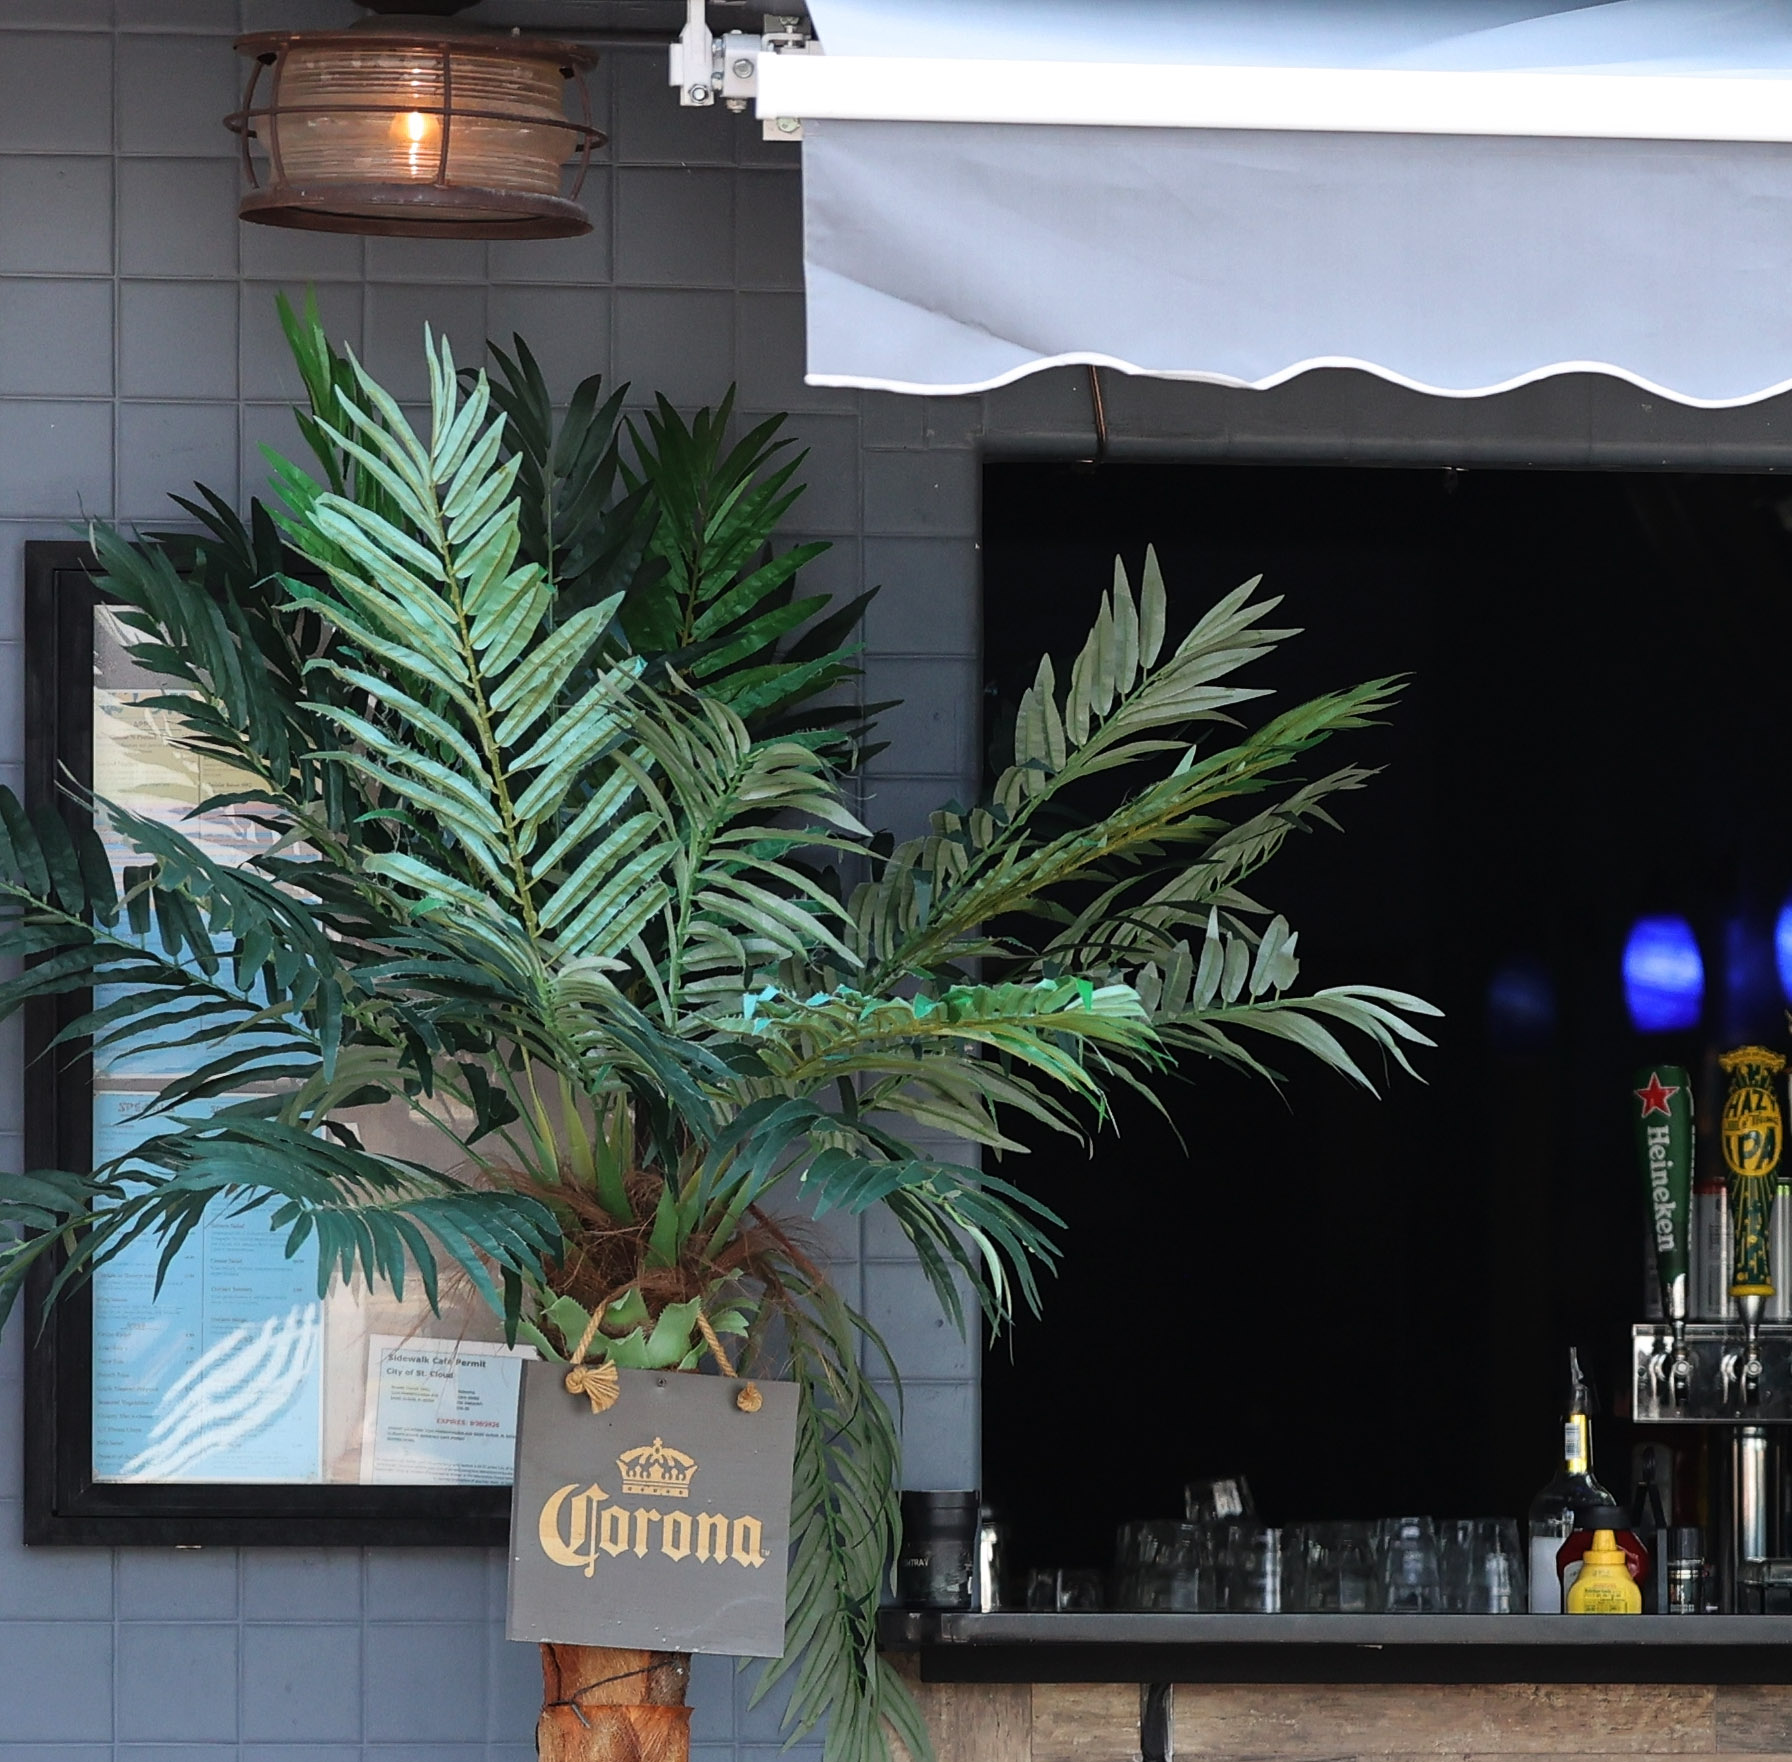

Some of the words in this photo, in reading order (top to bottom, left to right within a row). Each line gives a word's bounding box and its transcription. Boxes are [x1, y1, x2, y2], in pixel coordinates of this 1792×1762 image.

[1725, 1126, 1775, 1170] IPA
[1646, 1124, 1678, 1253] Heineken
[386, 1368, 402, 1378] City
[430, 1371, 454, 1379] Cloud
[388, 1354, 429, 1365] Sidewalk
[456, 1359, 486, 1368] Permit
[539, 1483, 765, 1578] Corona
